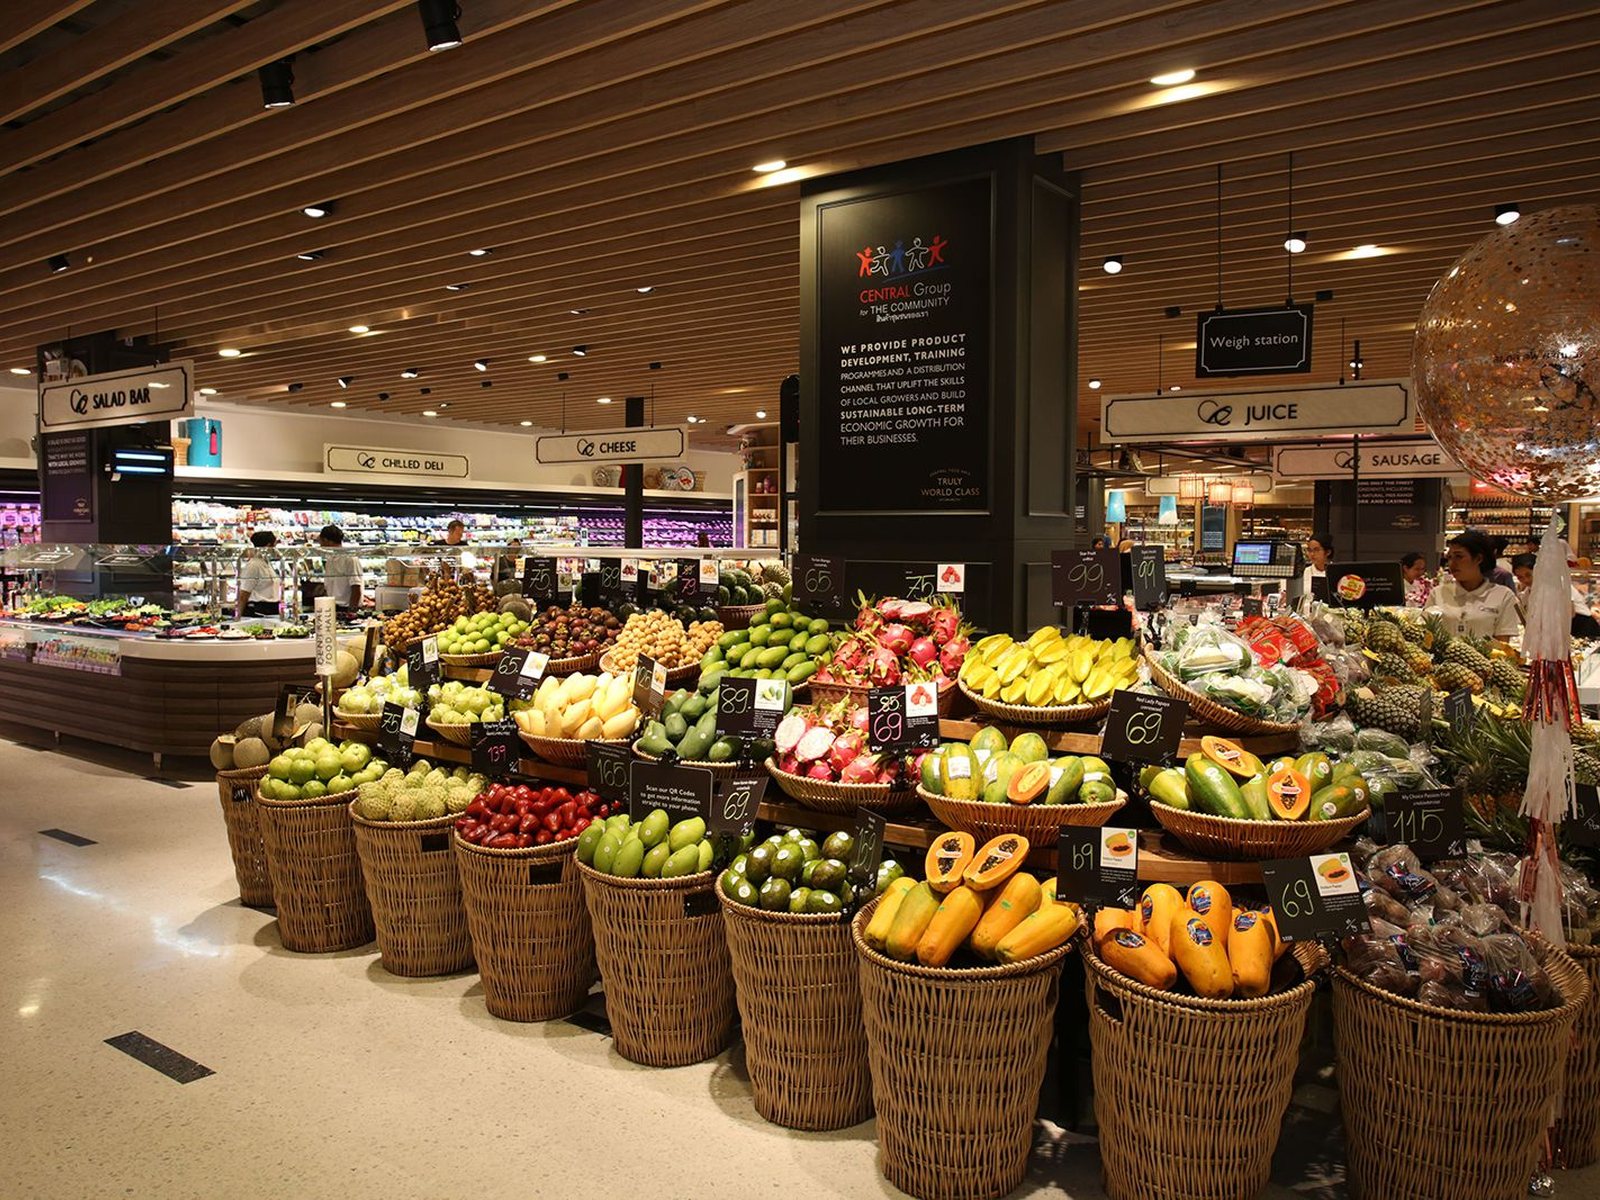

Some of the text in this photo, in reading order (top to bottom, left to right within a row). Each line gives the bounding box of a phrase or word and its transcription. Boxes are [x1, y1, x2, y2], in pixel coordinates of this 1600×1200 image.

[860, 282, 952, 303] CENTRAL Group
[870, 304, 888, 314] THE
[890, 297, 950, 312] COMMUNITY
[841, 333, 966, 354] WE PROVIDE PRODUCT
[1210, 333, 1298, 350] Weigh station
[841, 347, 966, 368] DEVELOPMENT, TRAINING
[840, 362, 966, 380] PROGRAMMES AND A DISTRIBUTION
[840, 376, 965, 394] CHANNEL THAT UPLIFT THE SKILLS
[92, 391, 126, 409] SALAD
[130, 388, 151, 405] BAR
[852, 397, 878, 406] LOCAL
[880, 393, 919, 404] GROWERS
[920, 392, 939, 401] AND
[941, 390, 966, 399] BUILD
[840, 403, 965, 419] SUSTAINABLE LONG-TERM
[1244, 404, 1298, 426] JUICE
[840, 416, 964, 433] ECONOMIC GROWTH FOR
[599, 440, 637, 454] CHEESE
[840, 435, 865, 446] THEIR
[382, 458, 420, 469] CHILLED
[424, 460, 444, 471] DELI
[1372, 453, 1441, 467] SAUSAGE
[937, 477, 962, 486] TRULY
[920, 487, 980, 496] WORLD CLASS
[678, 789, 695, 797] Codes
[1393, 808, 1445, 844] 115
[1281, 879, 1315, 918] 69
